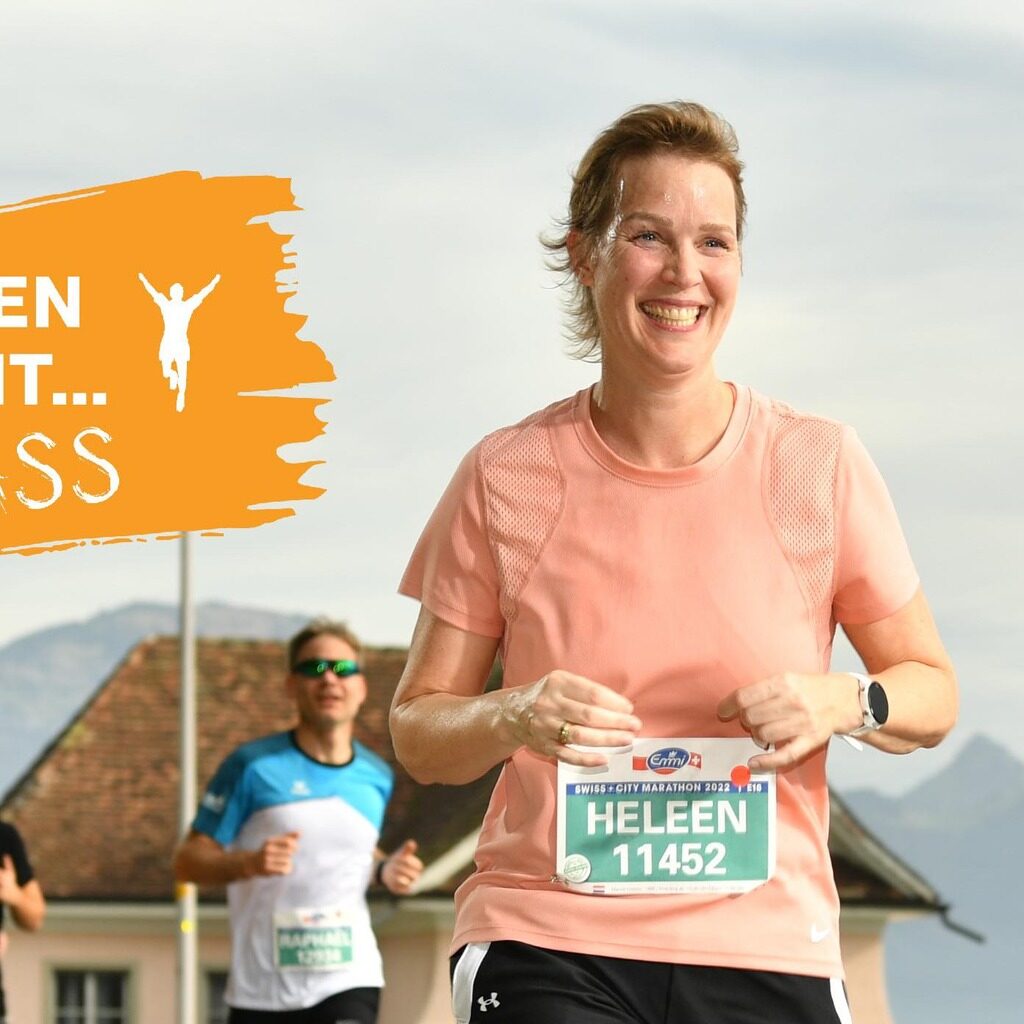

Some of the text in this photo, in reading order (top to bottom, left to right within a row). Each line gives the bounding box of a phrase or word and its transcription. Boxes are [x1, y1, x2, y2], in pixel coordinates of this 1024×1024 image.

[650, 753, 687, 767] Emmi
[575, 783, 606, 795] SWISS
[615, 783, 640, 793] CITY
[641, 782, 701, 793] MARATHON
[705, 782, 730, 792] 2022
[587, 800, 747, 835] HELEEN
[613, 842, 727, 876] 11452
